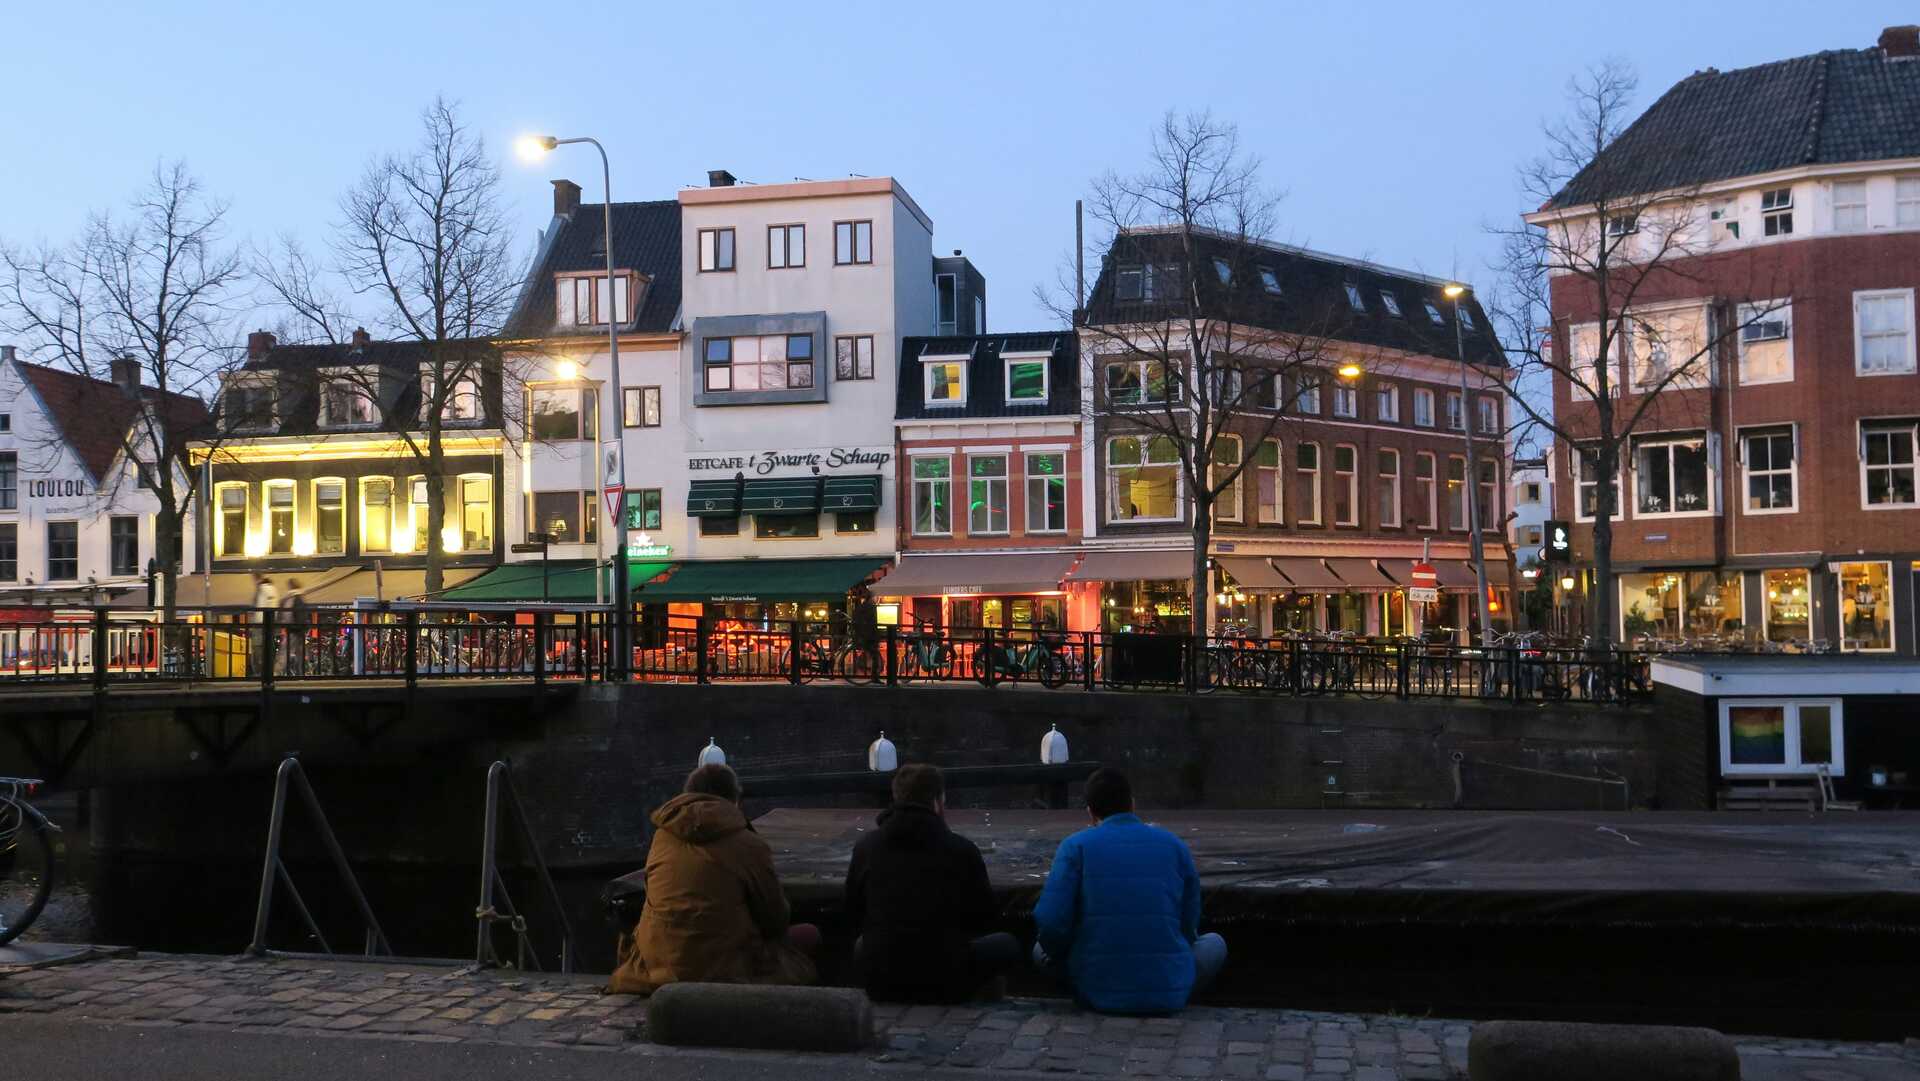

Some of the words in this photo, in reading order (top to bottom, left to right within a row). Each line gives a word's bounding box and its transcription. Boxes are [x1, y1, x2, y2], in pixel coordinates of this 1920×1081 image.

[757, 451, 820, 474] Zwarte
[825, 447, 890, 470] Schaap
[29, 480, 84, 498] LOULOU
